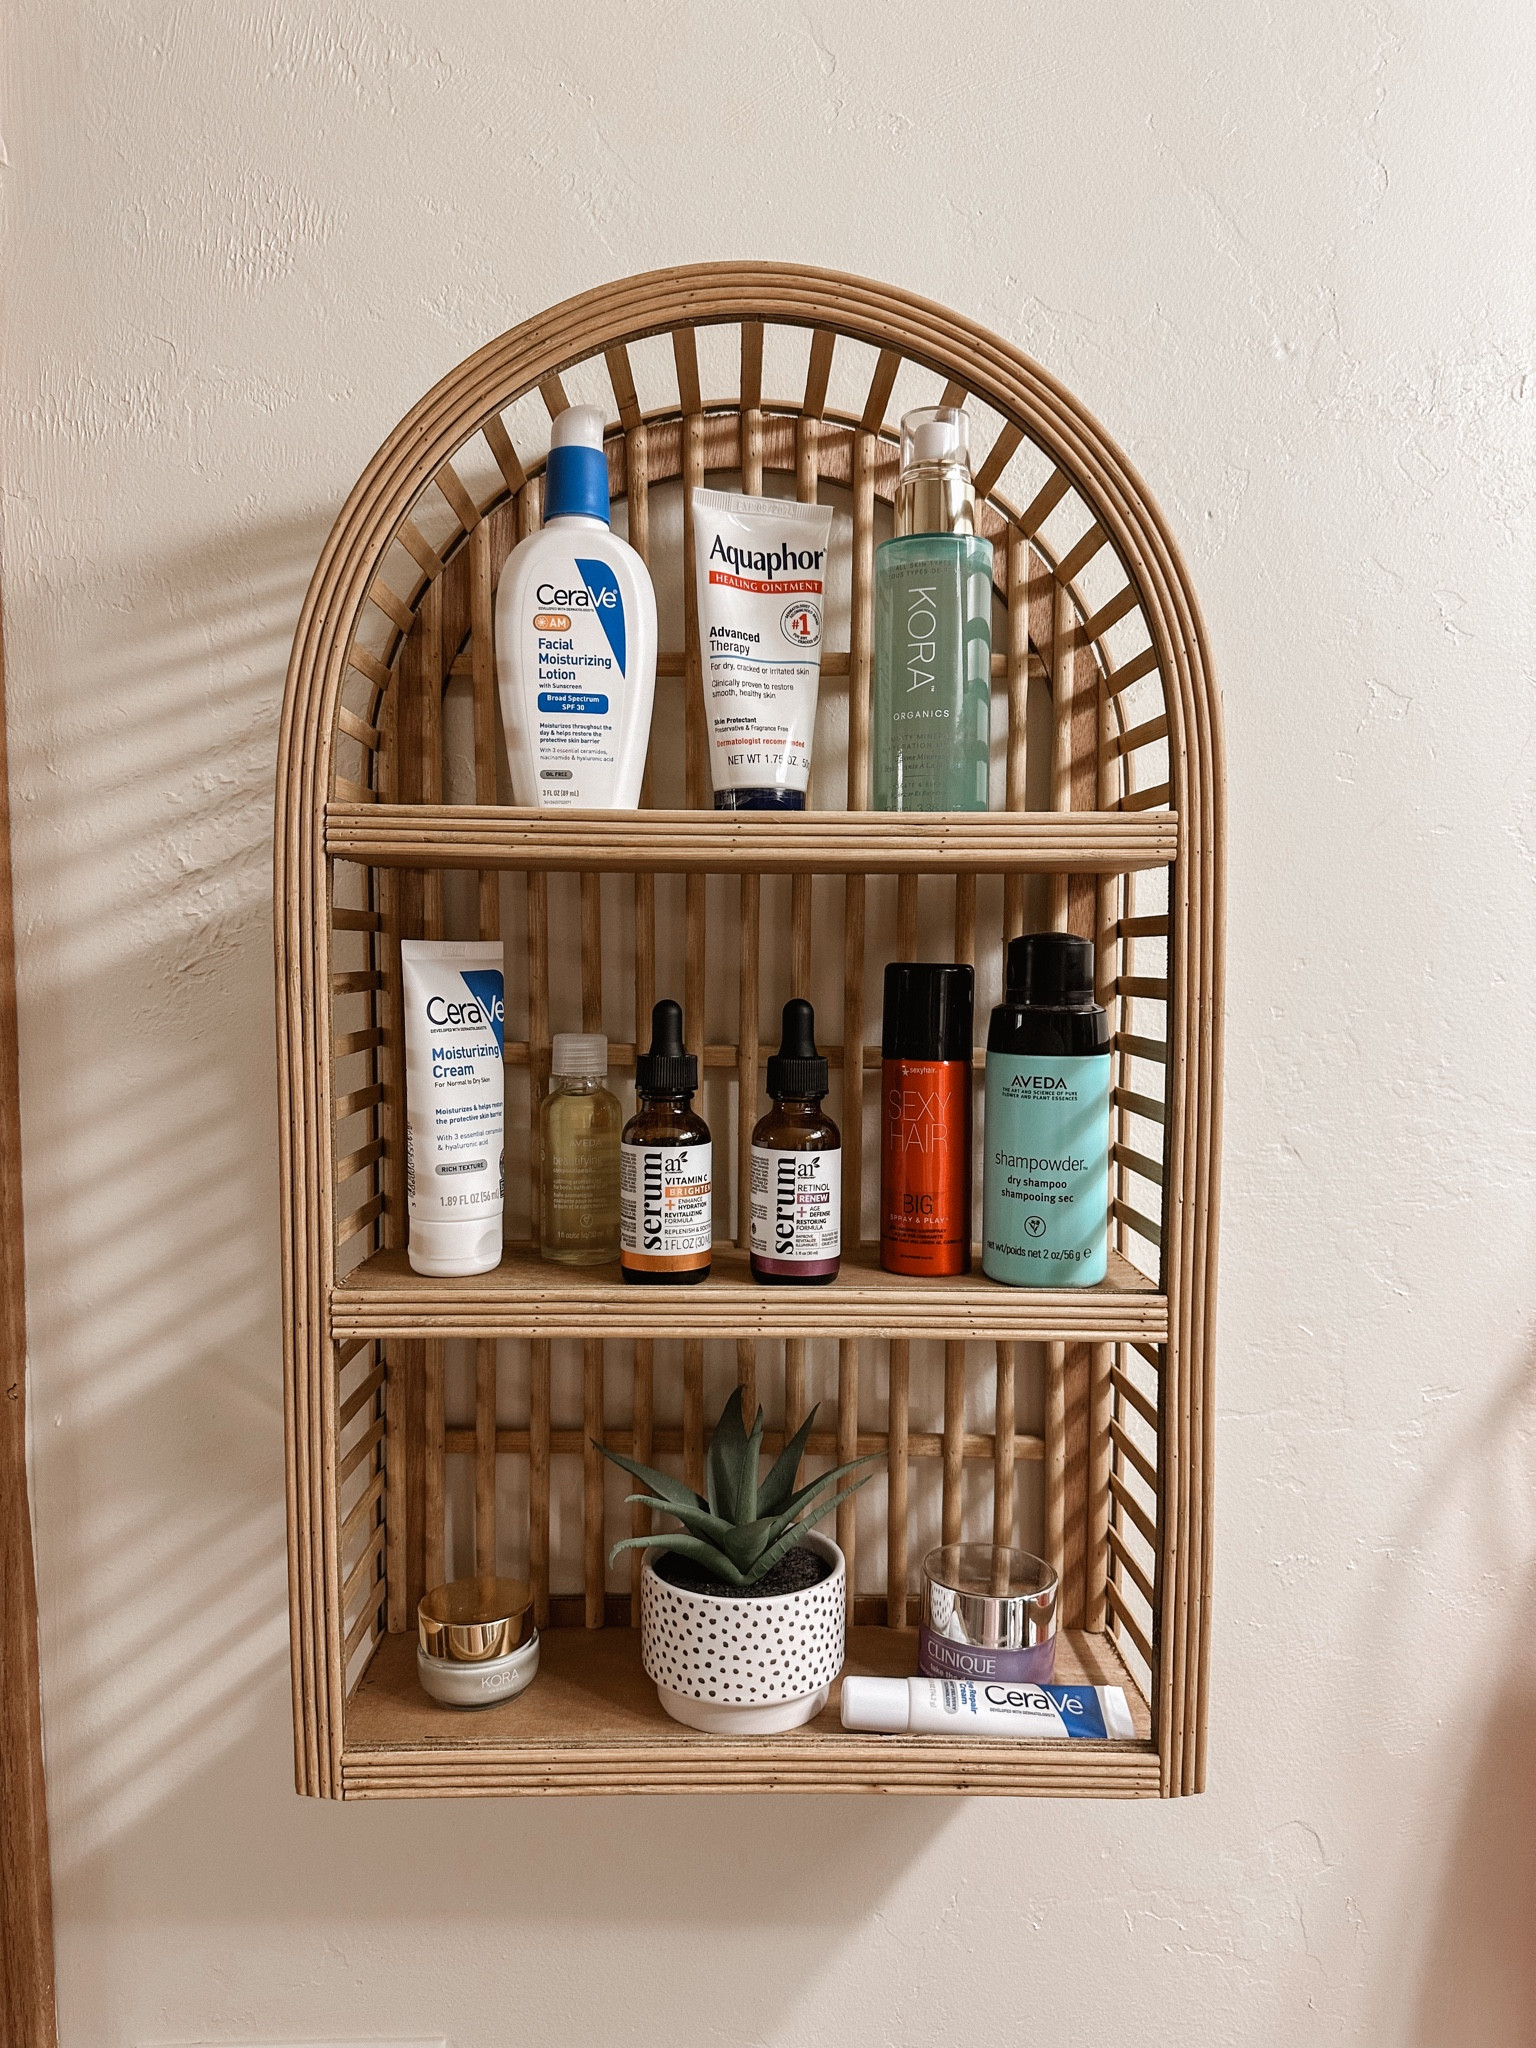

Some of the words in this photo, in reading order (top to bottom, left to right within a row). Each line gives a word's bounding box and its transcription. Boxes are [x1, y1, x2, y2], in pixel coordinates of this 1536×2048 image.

[710, 534, 824, 580] Aquaphor
[715, 573, 758, 591] HEALING
[761, 582, 819, 592] OINTMENT
[536, 584, 617, 608] CeraVe
[550, 618, 566, 628] AM
[792, 613, 810, 636] #1
[710, 626, 760, 643] Advanced
[907, 587, 936, 692] KORA
[538, 638, 574, 650] Facial
[710, 640, 750, 656] Therapy
[538, 653, 612, 669] Moisturizing
[538, 668, 576, 680] Lotion
[710, 662, 721, 670] For
[737, 664, 760, 673] cracked
[770, 667, 794, 675] irritated
[712, 679, 740, 688] Clinically
[764, 681, 770, 689] to
[568, 695, 600, 703] Spectrum
[712, 689, 738, 698] smooth,
[740, 689, 762, 699] healthy
[893, 709, 950, 720] ORGANICS
[572, 723, 602, 731] throughout
[716, 738, 761, 748] Dermatologist
[763, 739, 804, 748] recommnded
[728, 754, 744, 765] NET
[747, 754, 761, 763] WT
[426, 995, 504, 1025] CeraVe
[432, 1044, 499, 1061] Moisturizing
[433, 1065, 474, 1078] Cream
[1011, 1074, 1067, 1090] AVEDA
[436, 1106, 472, 1115] Moisturizes
[889, 1090, 951, 1122] SEXY
[449, 1115, 478, 1125] protective
[460, 1131, 484, 1139] essential
[890, 1122, 948, 1153] HAIR
[445, 1141, 477, 1151] hyaluronic
[569, 1139, 603, 1147] AVEDA
[995, 1150, 1084, 1173] shampowder
[665, 1175, 703, 1185] VITAMIN
[1007, 1175, 1021, 1187] dry
[1023, 1178, 1067, 1190] shampoo
[798, 1184, 830, 1192] RETINOL
[440, 1196, 457, 1206] 1.89
[460, 1196, 468, 1205] FL
[470, 1194, 479, 1203] OZ
[481, 1192, 490, 1203] (56
[643, 1152, 662, 1250] serum
[800, 1194, 828, 1202] RENEW
[1001, 1188, 1056, 1204] shampooing
[678, 1202, 707, 1210] HYDRATION
[775, 1157, 796, 1255] serum
[903, 1194, 933, 1214] BIG
[664, 1210, 702, 1218] REVITALIZING
[890, 1214, 912, 1222] SPRAY
[664, 1240, 668, 1250] 1
[671, 1240, 681, 1250] FL
[682, 1238, 694, 1249] OZ
[996, 1243, 1026, 1257] wt/poids
[1028, 1248, 1041, 1258] net
[1043, 1249, 1048, 1259] 2
[1051, 1250, 1074, 1260] oz/56
[1075, 1252, 1080, 1261] g
[928, 1640, 996, 1674] CLINIQUE
[930, 1663, 944, 1676] take
[481, 1668, 520, 1689] KORA
[969, 1690, 978, 1714] Repair
[985, 1685, 1084, 1715] CeraVe
